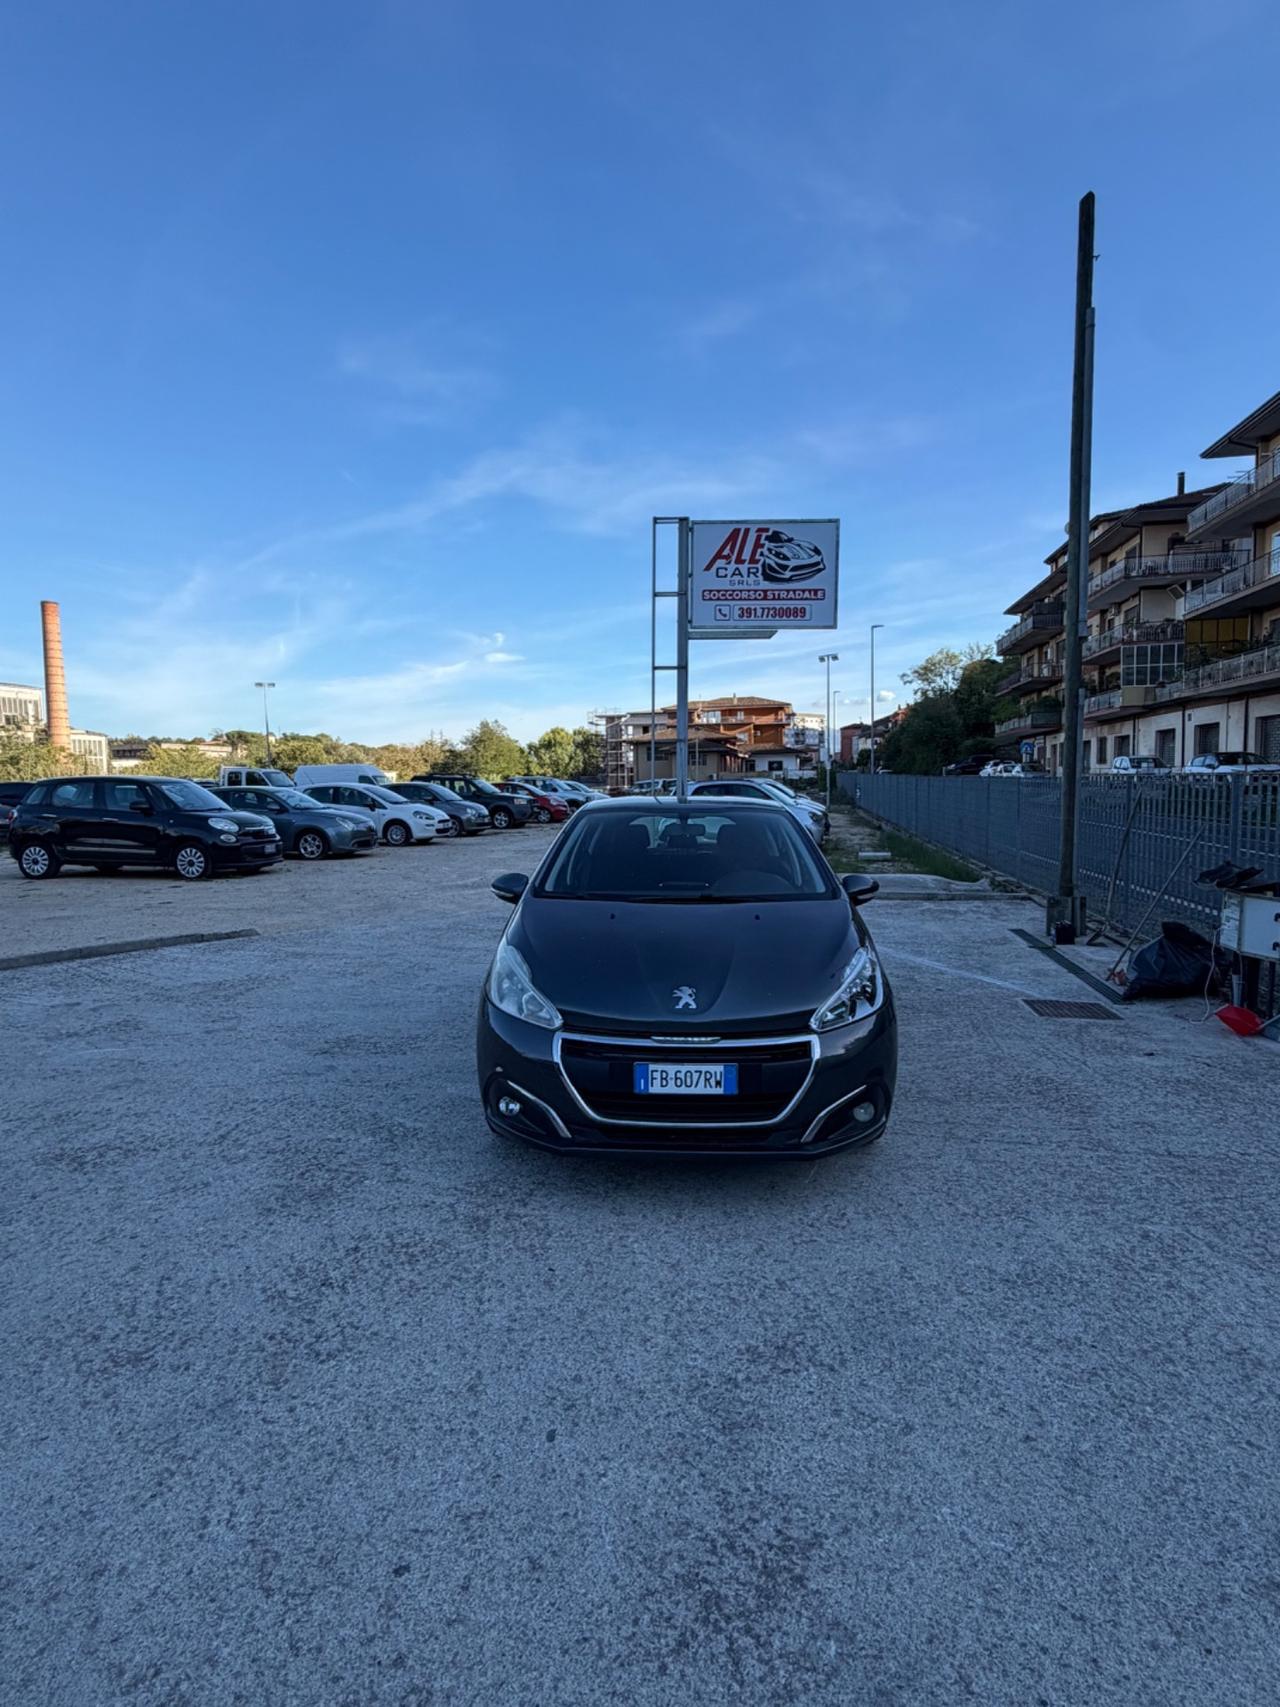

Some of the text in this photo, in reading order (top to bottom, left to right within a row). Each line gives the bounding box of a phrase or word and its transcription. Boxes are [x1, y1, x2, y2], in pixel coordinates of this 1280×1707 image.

[703, 527, 770, 571] ALE
[716, 567, 760, 578] CAR
[729, 579, 760, 587] SRLS
[703, 590, 824, 600] SOCCORSO STRADALE
[737, 607, 806, 619] 391.7730089
